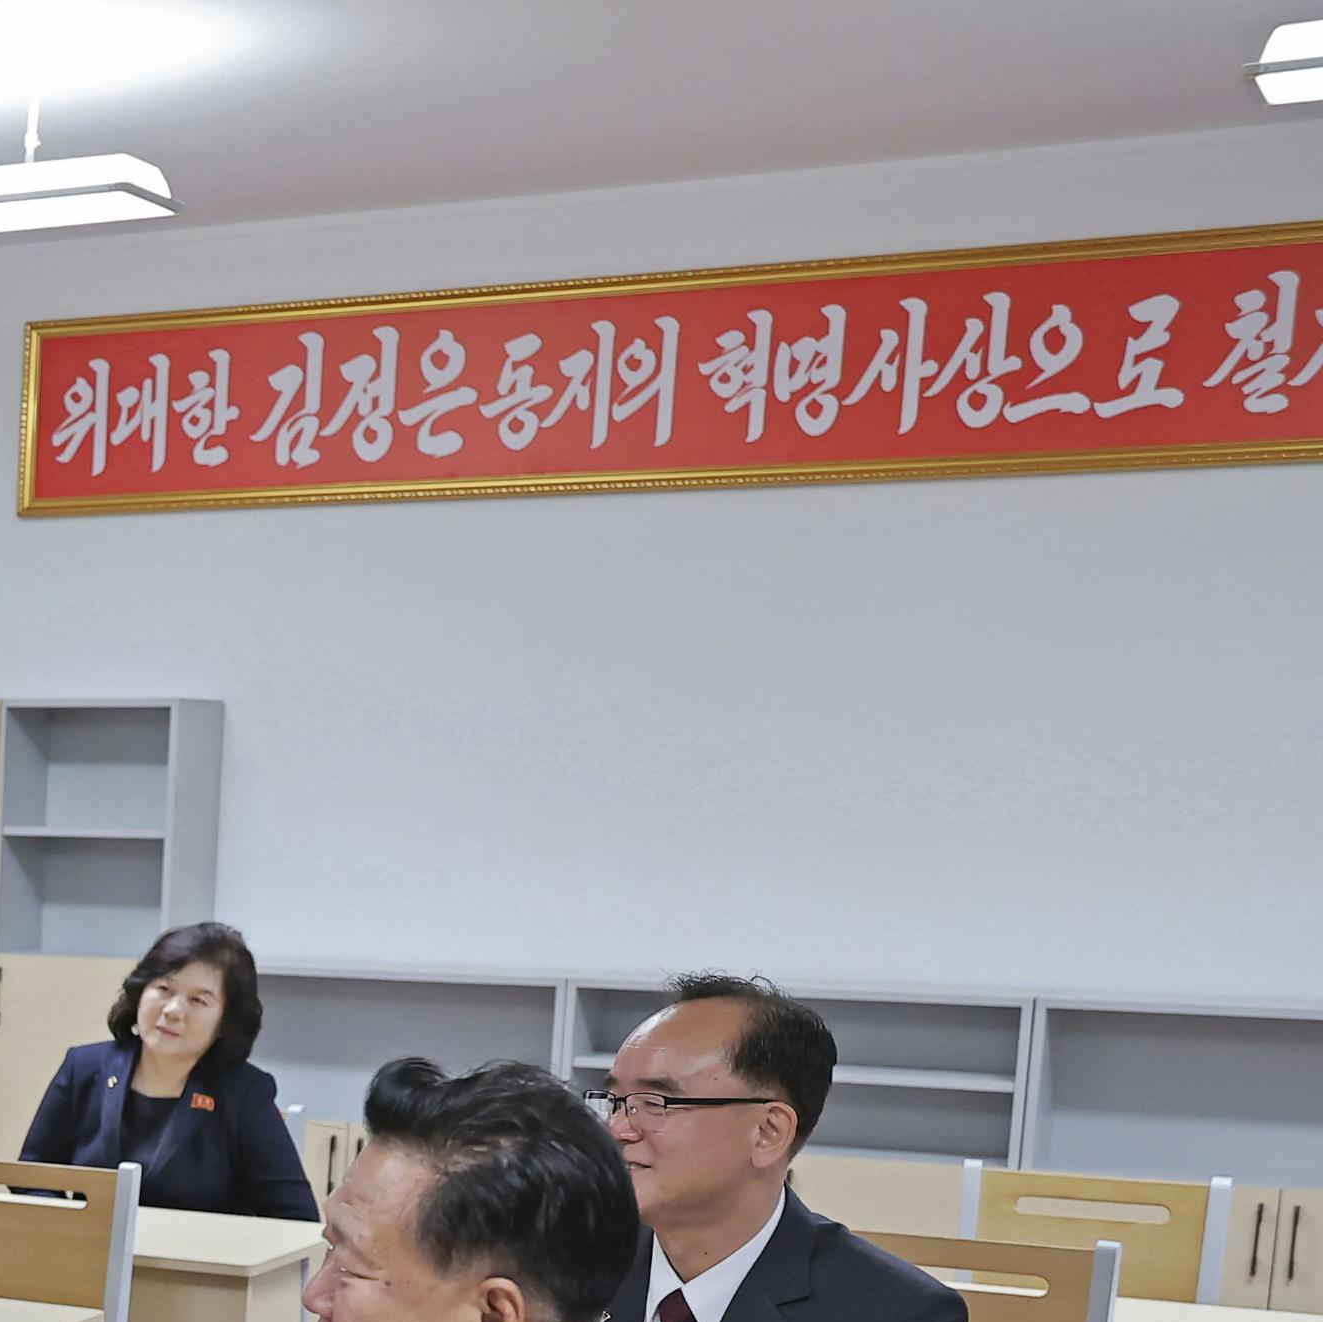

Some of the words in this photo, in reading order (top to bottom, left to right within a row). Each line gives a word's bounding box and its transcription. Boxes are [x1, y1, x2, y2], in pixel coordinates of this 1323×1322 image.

[51, 348, 239, 476] 위대한
[249, 315, 680, 470] 김정은동지의
[698, 291, 1184, 443] 혁명사상으로
